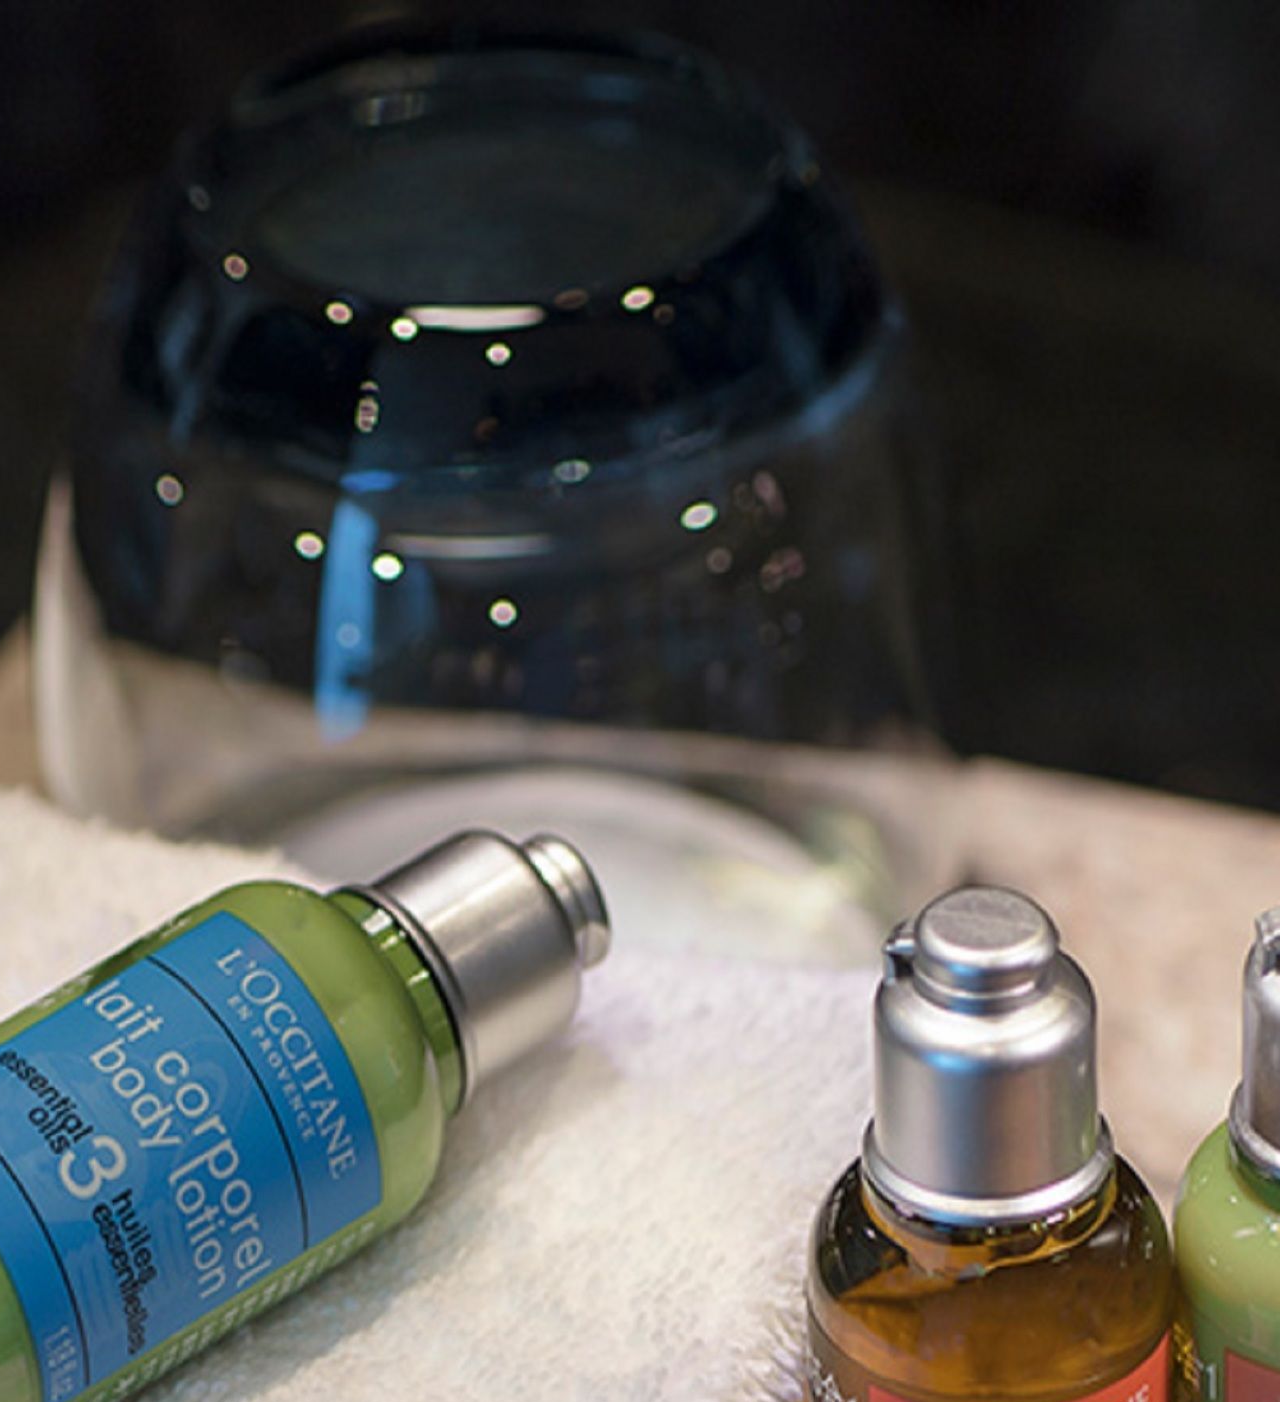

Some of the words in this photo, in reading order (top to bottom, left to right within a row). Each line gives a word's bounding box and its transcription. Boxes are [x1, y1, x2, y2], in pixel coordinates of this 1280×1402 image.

[27, 1105, 71, 1156] oils
[84, 979, 164, 1043] lait
[154, 1050, 273, 1289] corporel
[216, 948, 357, 1181] L'OCCITANE
[225, 994, 253, 1022] EN
[250, 1025, 317, 1142] PROVENCE
[59, 1134, 128, 1199] 3
[89, 1037, 182, 1150] body
[167, 1149, 227, 1300] lotion
